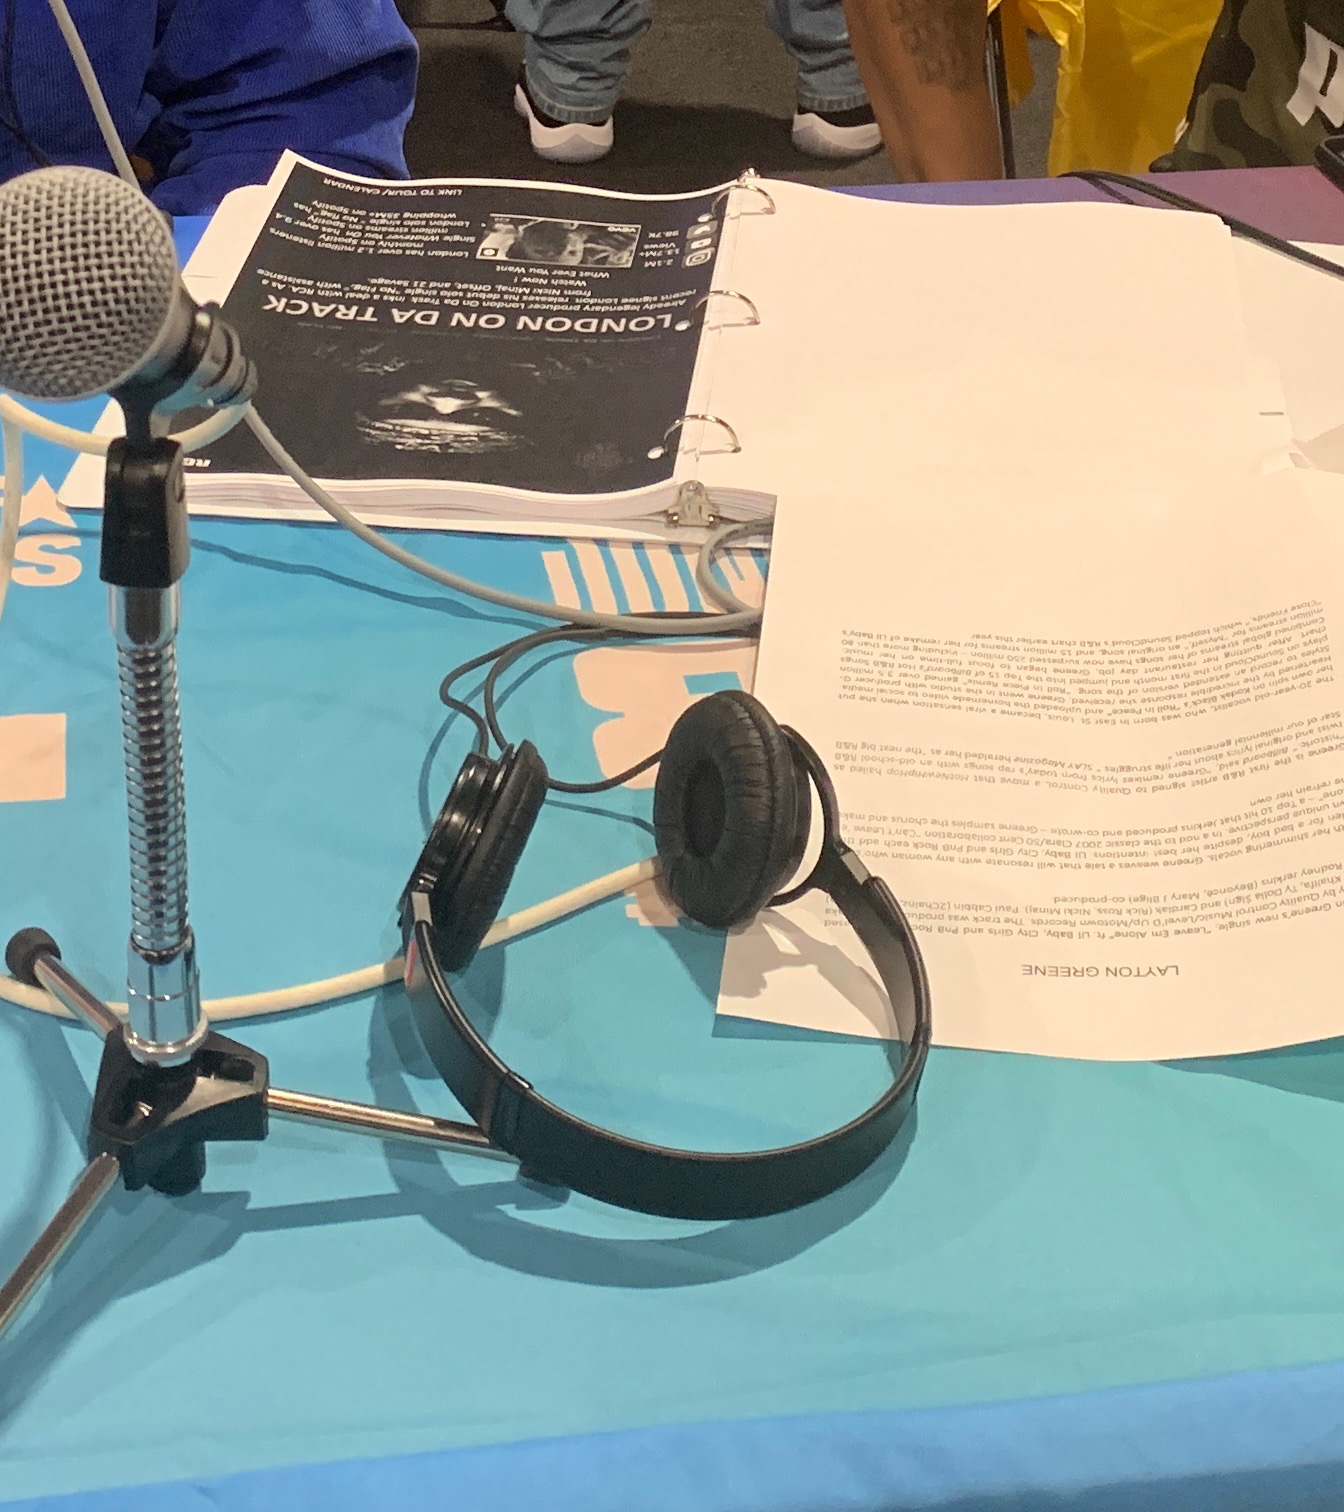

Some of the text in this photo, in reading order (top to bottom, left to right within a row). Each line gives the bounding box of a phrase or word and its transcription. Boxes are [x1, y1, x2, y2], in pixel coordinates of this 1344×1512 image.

[323, 178, 381, 195] CALENDAR
[495, 265, 609, 279] What Ever You Want
[316, 281, 341, 289] with
[428, 281, 451, 289] and
[521, 277, 548, 285] Now
[551, 279, 587, 287] Watch
[318, 289, 343, 297] with
[466, 292, 501, 300] debut
[262, 295, 378, 322] TRACK
[482, 301, 525, 310] London
[528, 303, 581, 311] producer
[583, 303, 640, 312] legendary
[643, 299, 686, 311] Already
[391, 308, 440, 325] DA
[450, 312, 506, 329] ON
[516, 314, 672, 333] LONDON
[1300, 862, 1343, 877] Rodney
[1260, 872, 1298, 885] Jerkins
[1171, 892, 1200, 901] Mary
[1255, 888, 1283, 900] Dolla
[1322, 887, 1336, 899] by
[1279, 892, 1320, 907] Quality
[995, 905, 1019, 914] Paul
[1155, 903, 1198, 916] Cardiak
[1200, 900, 1221, 910] and
[1235, 901, 1278, 917] Control
[1064, 907, 1091, 916] Nicki
[948, 914, 969, 923] was
[972, 915, 1001, 925] track
[1003, 917, 1024, 926] The
[1255, 913, 1279, 925] new
[911, 924, 933, 934] Roc
[937, 925, 959, 935] PnB
[963, 927, 984, 936] and
[988, 927, 1014, 937] Girls
[1017, 928, 1039, 938] City
[1151, 929, 1170, 938] Em
[1021, 964, 1180, 978] LAYTON GREENE
